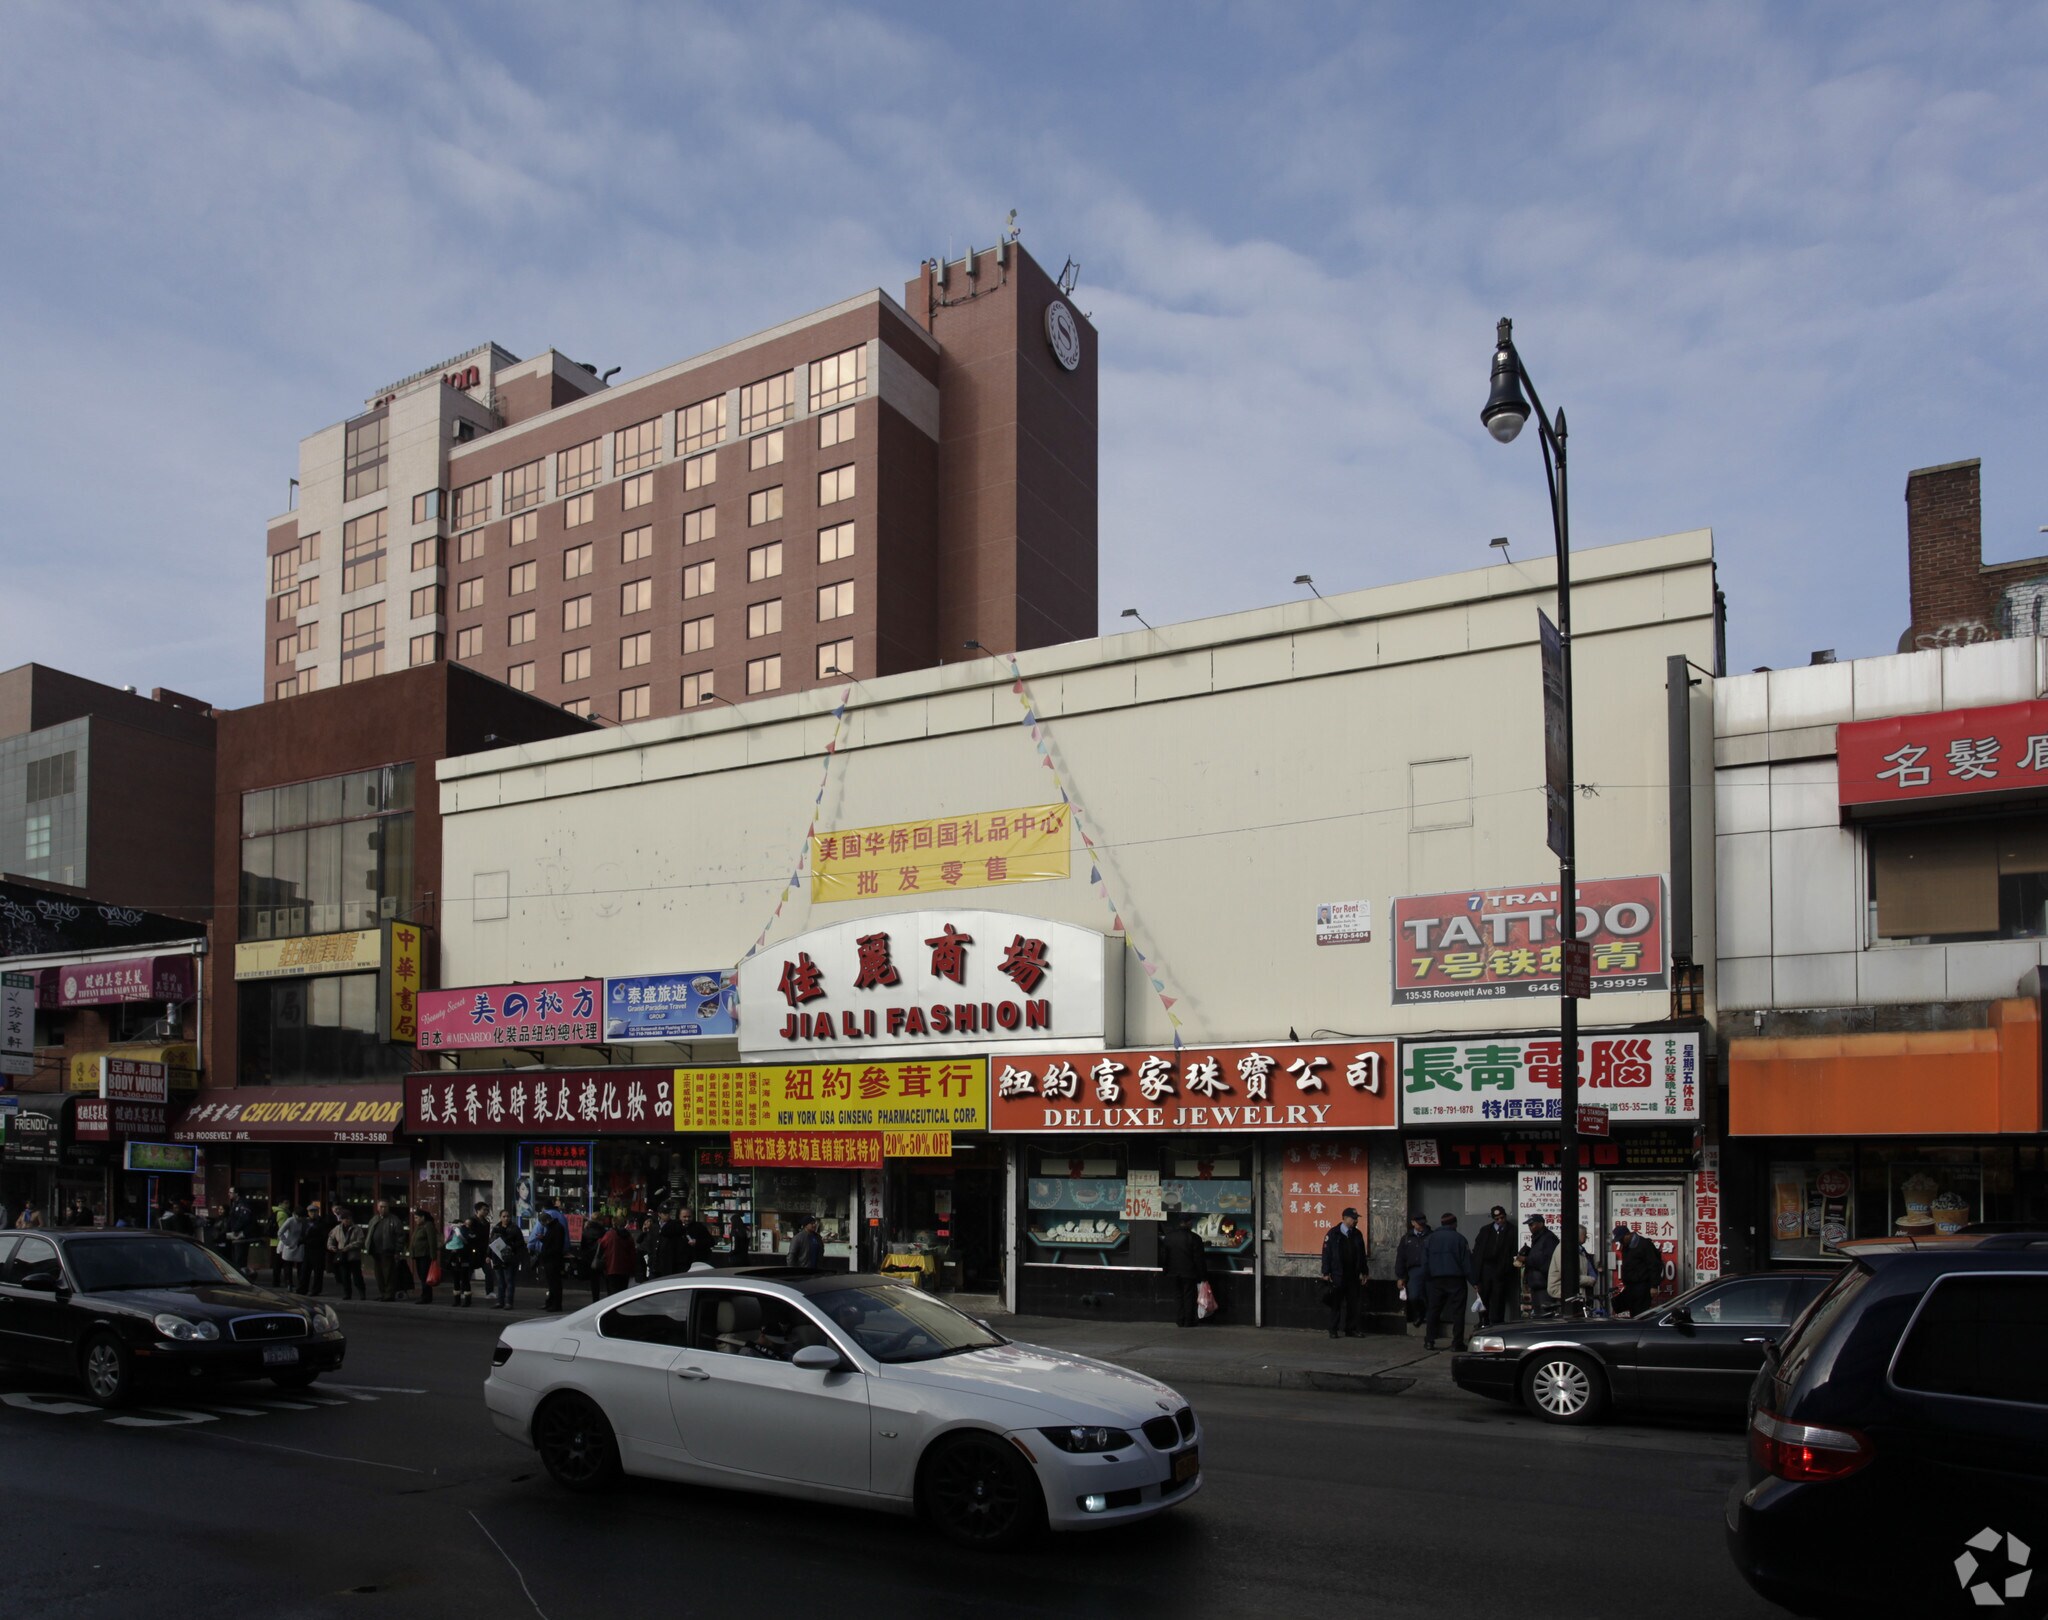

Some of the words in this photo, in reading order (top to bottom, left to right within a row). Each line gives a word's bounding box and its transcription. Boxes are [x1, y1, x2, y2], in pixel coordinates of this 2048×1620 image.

[819, 811, 1064, 863] 美国华侨回国礼品中心
[858, 856, 1007, 895] 批发零售
[1332, 905, 1342, 914] For
[1344, 904, 1359, 912] Rent
[1470, 896, 1481, 909] 7
[1487, 889, 1580, 906] TRAI
[1403, 901, 1651, 951] TATTOO
[1318, 932, 1369, 941] 347-470-5404
[778, 922, 1050, 1006] 佳麗商場
[396, 928, 417, 1038] 中華書局
[1405, 989, 1432, 1000] 135-35
[1433, 988, 1476, 998] Roosevelt
[1477, 987, 1494, 997] Ave
[1496, 986, 1506, 996] 3B
[1528, 977, 1648, 994] 6469-9995
[627, 984, 688, 1005] 泰盛旅遊
[470, 987, 595, 1025] 美の秘方
[627, 1005, 645, 1013] Grand
[645, 1004, 669, 1012] Paradise
[780, 1011, 835, 1040] JIA
[842, 1008, 875, 1037] LI
[886, 998, 1051, 1035] FASHION
[422, 1031, 442, 1047] 日本
[1403, 1039, 1652, 1093] 長青電腦
[108, 1074, 133, 1091] BODY
[135, 1076, 164, 1093] WORK
[784, 1064, 974, 1101] 紐約參茸行
[998, 1051, 1384, 1102] 紐約富家珠寶公司
[1683, 1044, 1694, 1112] 星期五休息
[762, 1078, 770, 1119] 深海魚油
[240, 1101, 306, 1122] CHUNG
[300, 1101, 348, 1122] HWA
[346, 1101, 403, 1122] BOOK
[778, 1111, 793, 1124] NEW
[797, 1111, 817, 1124] YORK
[820, 1110, 835, 1124] USA
[838, 1110, 873, 1124] GINSENG
[878, 1108, 949, 1123] PHARMACEUTICAL
[954, 1108, 977, 1123] CORP.
[1043, 1107, 1165, 1127] DELUXE
[1173, 1104, 1332, 1126] JEWELRY
[1482, 1099, 1562, 1119] 特價電腦
[1587, 1109, 1607, 1117] STANDING
[14, 1118, 49, 1130] FRIENDLY
[174, 1132, 194, 1140] 135-29
[196, 1132, 232, 1140] ROOSEVELT
[236, 1132, 250, 1140] AVE.
[334, 1132, 387, 1142] 718-353-3580
[885, 1132, 930, 1155] 20%-50%
[932, 1132, 950, 1154] OFF
[1516, 1130, 1561, 1140] TRAI
[733, 1136, 882, 1163] 威洲花旗参农场直销新张特价
[1522, 1176, 1533, 1191] 中文
[1534, 1176, 1562, 1191] Wind
[1579, 1176, 1588, 1192] 8
[1126, 1198, 1151, 1217] 50%
[1695, 1171, 1718, 1271] 長青電腦
